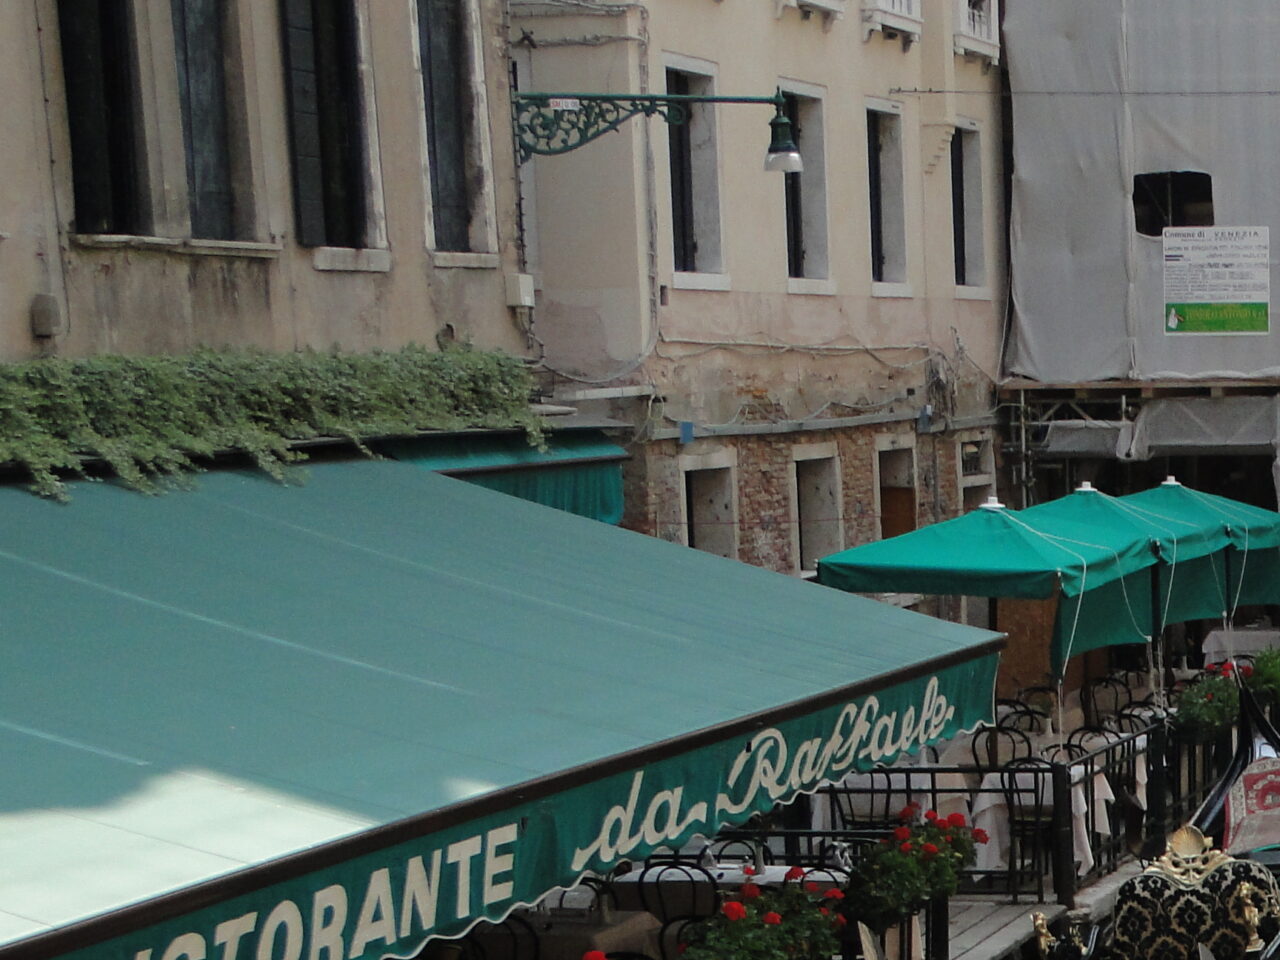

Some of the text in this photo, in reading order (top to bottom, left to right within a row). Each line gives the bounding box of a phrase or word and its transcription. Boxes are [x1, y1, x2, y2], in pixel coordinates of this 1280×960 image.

[1164, 230, 1194, 238] Comune
[1197, 230, 1205, 238] di
[571, 770, 708, 872] da
[716, 676, 955, 815] Raffaele
